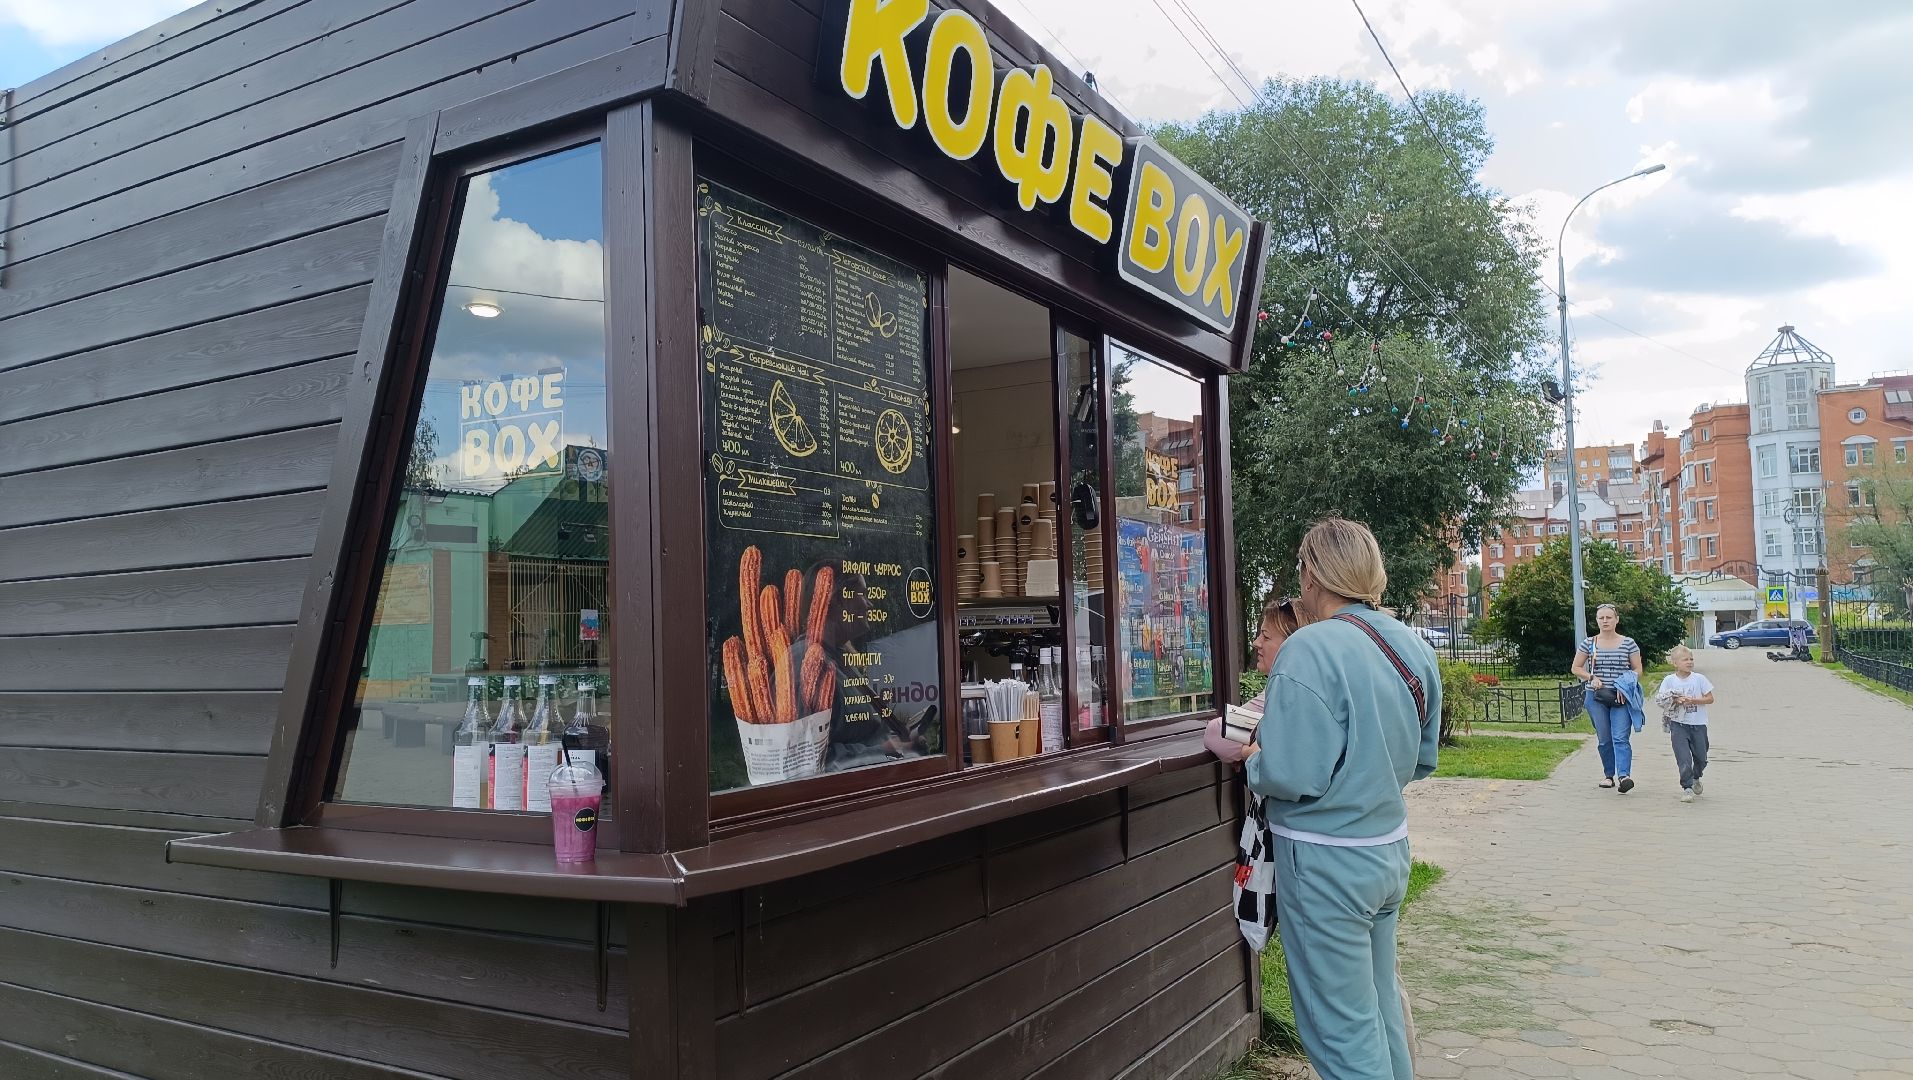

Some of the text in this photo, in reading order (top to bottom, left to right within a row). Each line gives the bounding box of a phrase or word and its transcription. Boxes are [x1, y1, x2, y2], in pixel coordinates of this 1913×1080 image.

[841, 0, 1123, 244] КОФЕ
[1129, 160, 1243, 318] BOX
[461, 372, 564, 420] КОФЕ
[464, 419, 560, 477] BOX
[721, 440, 741, 454] 400
[840, 461, 855, 474] 400
[1145, 449, 1179, 479] КОФЕ
[1146, 477, 1178, 511] BOX
[842, 559, 902, 577] ВАФЛИ ЧУРРОС
[910, 580, 930, 592] КОФЕ
[910, 591, 930, 603] BOX
[842, 652, 882, 667] ТОПИНГИ
